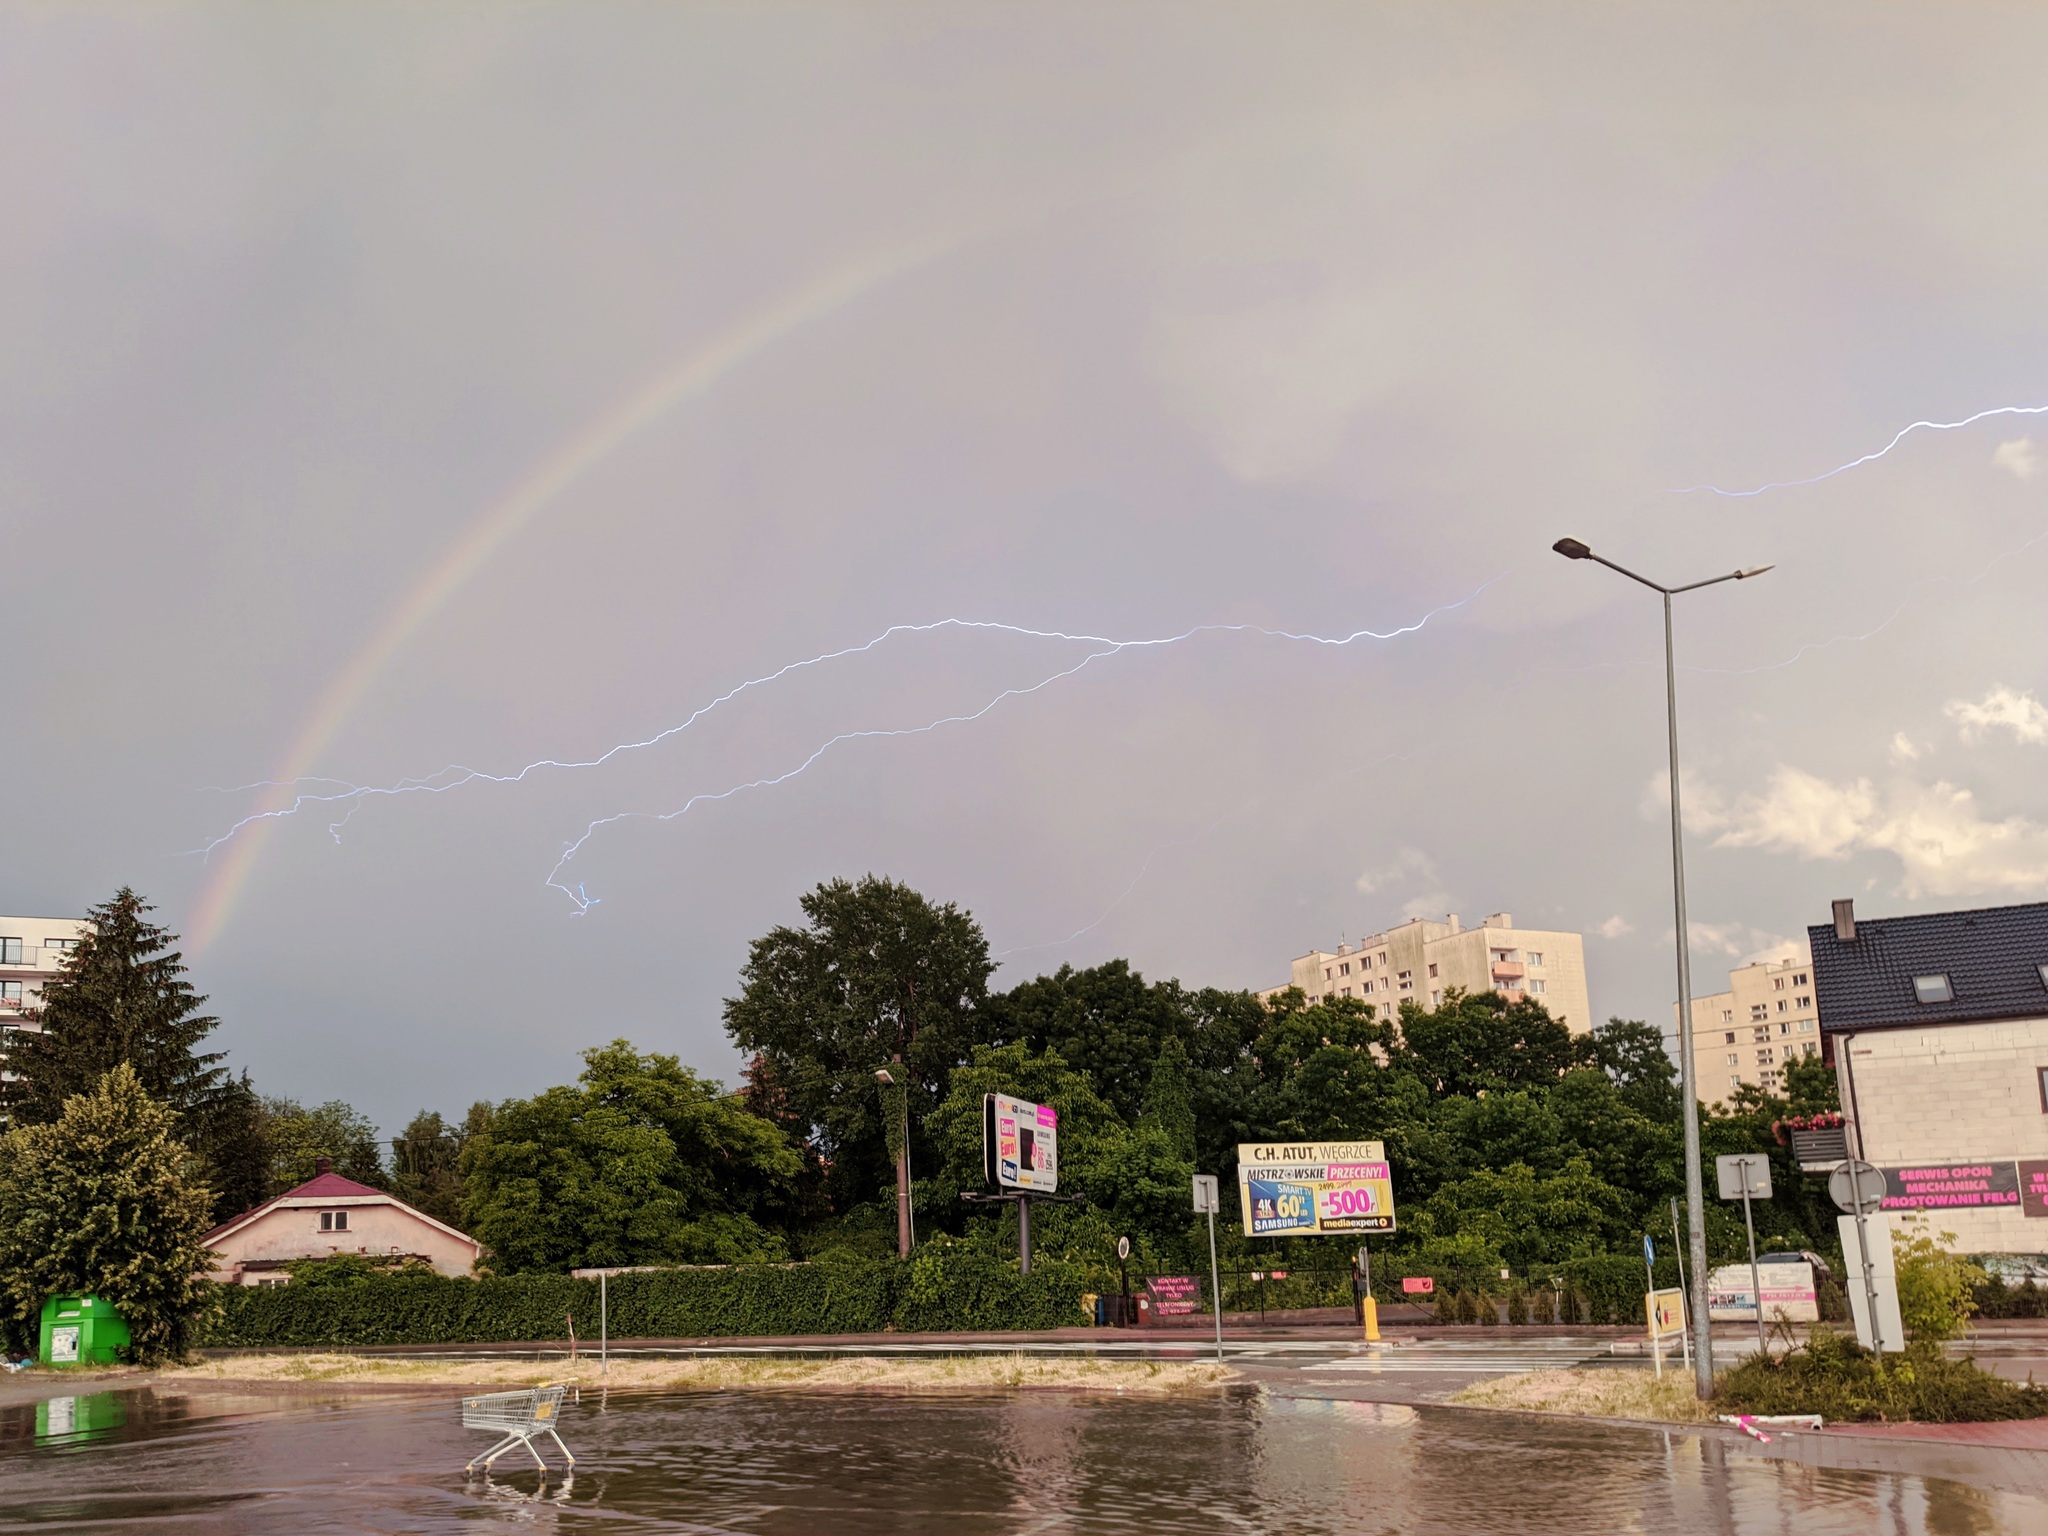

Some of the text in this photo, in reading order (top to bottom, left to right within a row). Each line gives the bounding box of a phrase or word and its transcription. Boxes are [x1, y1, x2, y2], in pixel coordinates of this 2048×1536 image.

[1000, 1140, 1017, 1156] Euro!
[1254, 1145, 1372, 1162] C.H. ATUT, WĘGRZCE
[1330, 1166, 1383, 1179] PRZECENY!
[1899, 1166, 1993, 1181] SERWIS OPON
[1278, 1184, 1312, 1196] SMART TV
[1906, 1180, 1989, 1193] MECHANIKA
[1258, 1199, 1272, 1210] 4K
[1882, 1191, 2018, 1208] PROSTOWANIE FELG
[1324, 1217, 1379, 1229] mediaexpert
